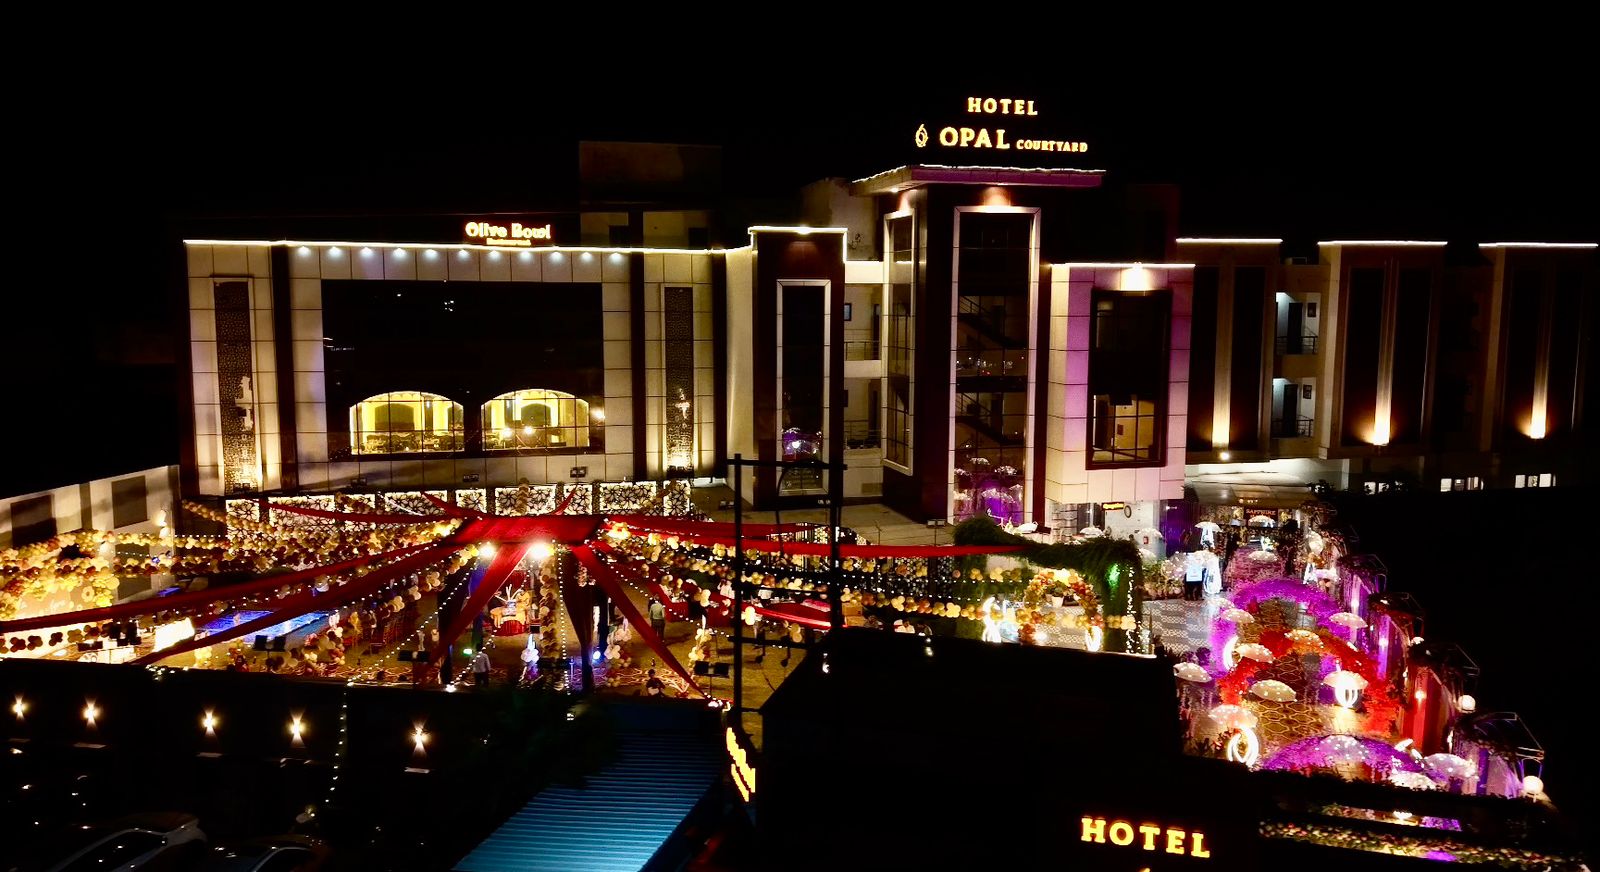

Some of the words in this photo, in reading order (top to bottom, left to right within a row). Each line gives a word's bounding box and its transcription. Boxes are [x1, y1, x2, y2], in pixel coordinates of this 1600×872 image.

[967, 97, 1038, 116] HOTEL
[939, 126, 1010, 149] OPAL
[1016, 139, 1088, 153] COURTYARD
[465, 221, 508, 238] Olive
[511, 222, 551, 240] Bowl
[1080, 816, 1210, 858] HOTEL
